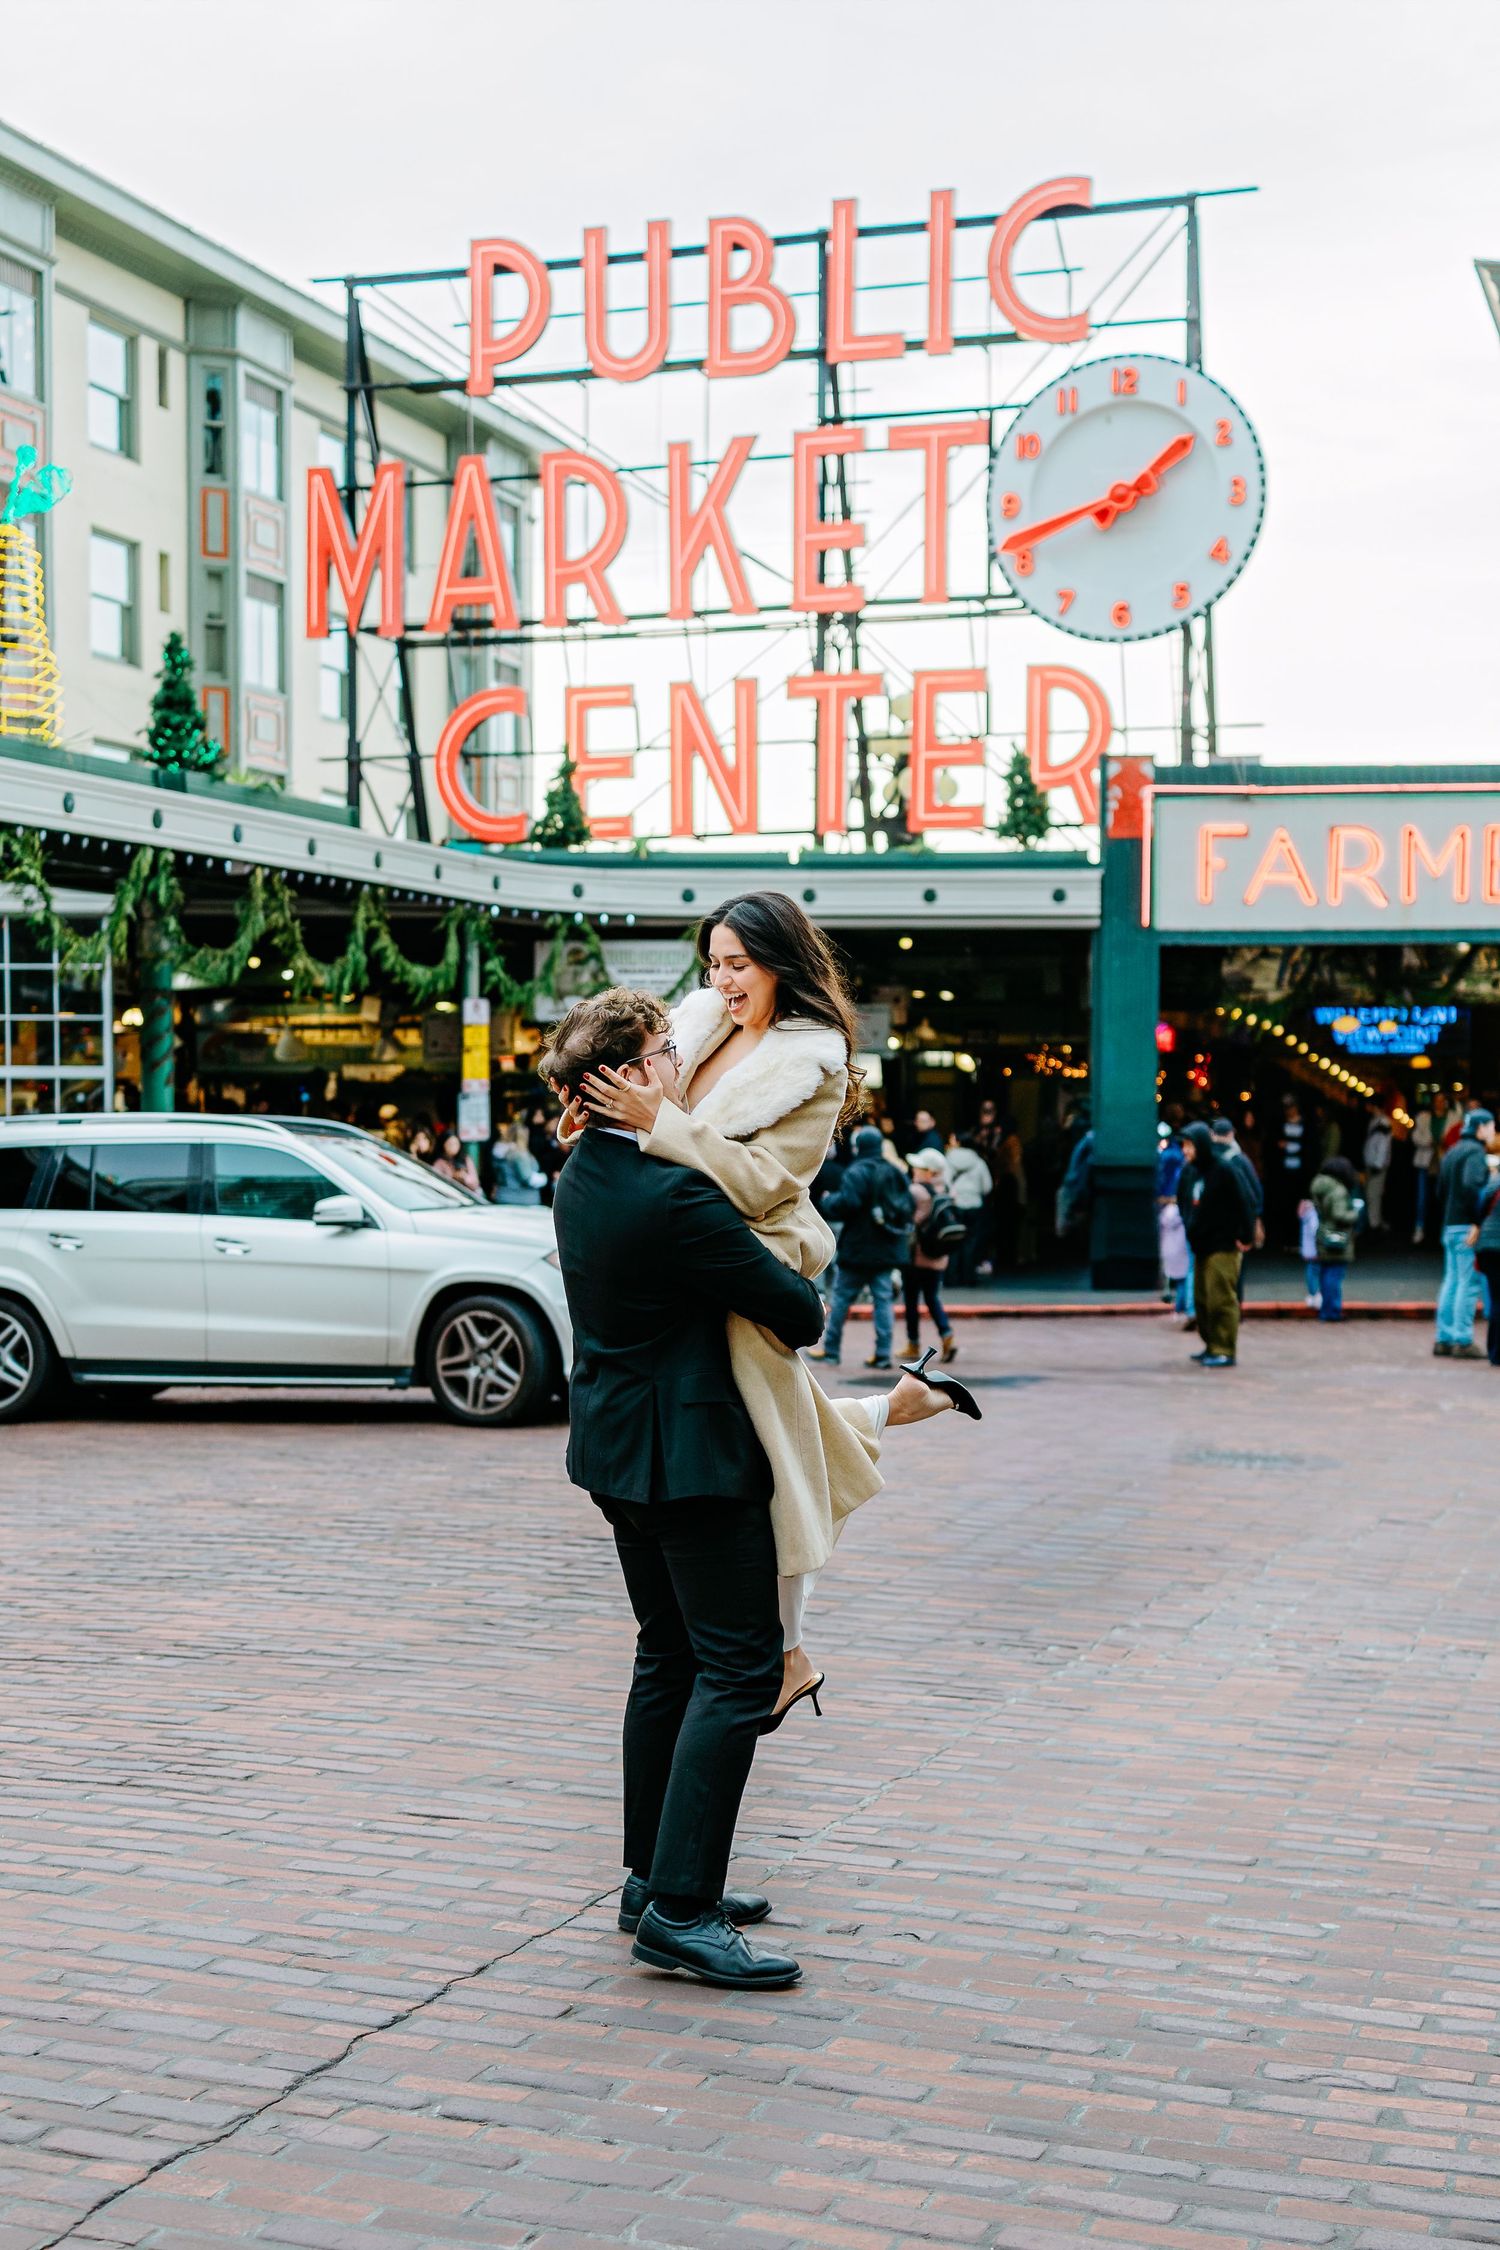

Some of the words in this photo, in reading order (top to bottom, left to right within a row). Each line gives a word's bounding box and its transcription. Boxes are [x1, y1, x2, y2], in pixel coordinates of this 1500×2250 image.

[467, 176, 1094, 397] PUBLIC
[1111, 367, 1139, 396] 12
[1177, 379, 1187, 406] 1
[1056, 387, 1078, 415] 11
[1015, 432, 1042, 461] 10
[1215, 418, 1233, 447] 2
[1001, 492, 1022, 519] 9
[1228, 476, 1248, 506] 3
[306, 419, 990, 639] MARKET
[1014, 549, 1035, 576] 8
[1208, 537, 1231, 565] 4
[1057, 588, 1076, 616] 7
[1171, 581, 1191, 610] 5
[1110, 600, 1131, 629] 6
[436, 664, 1113, 843] CENTER
